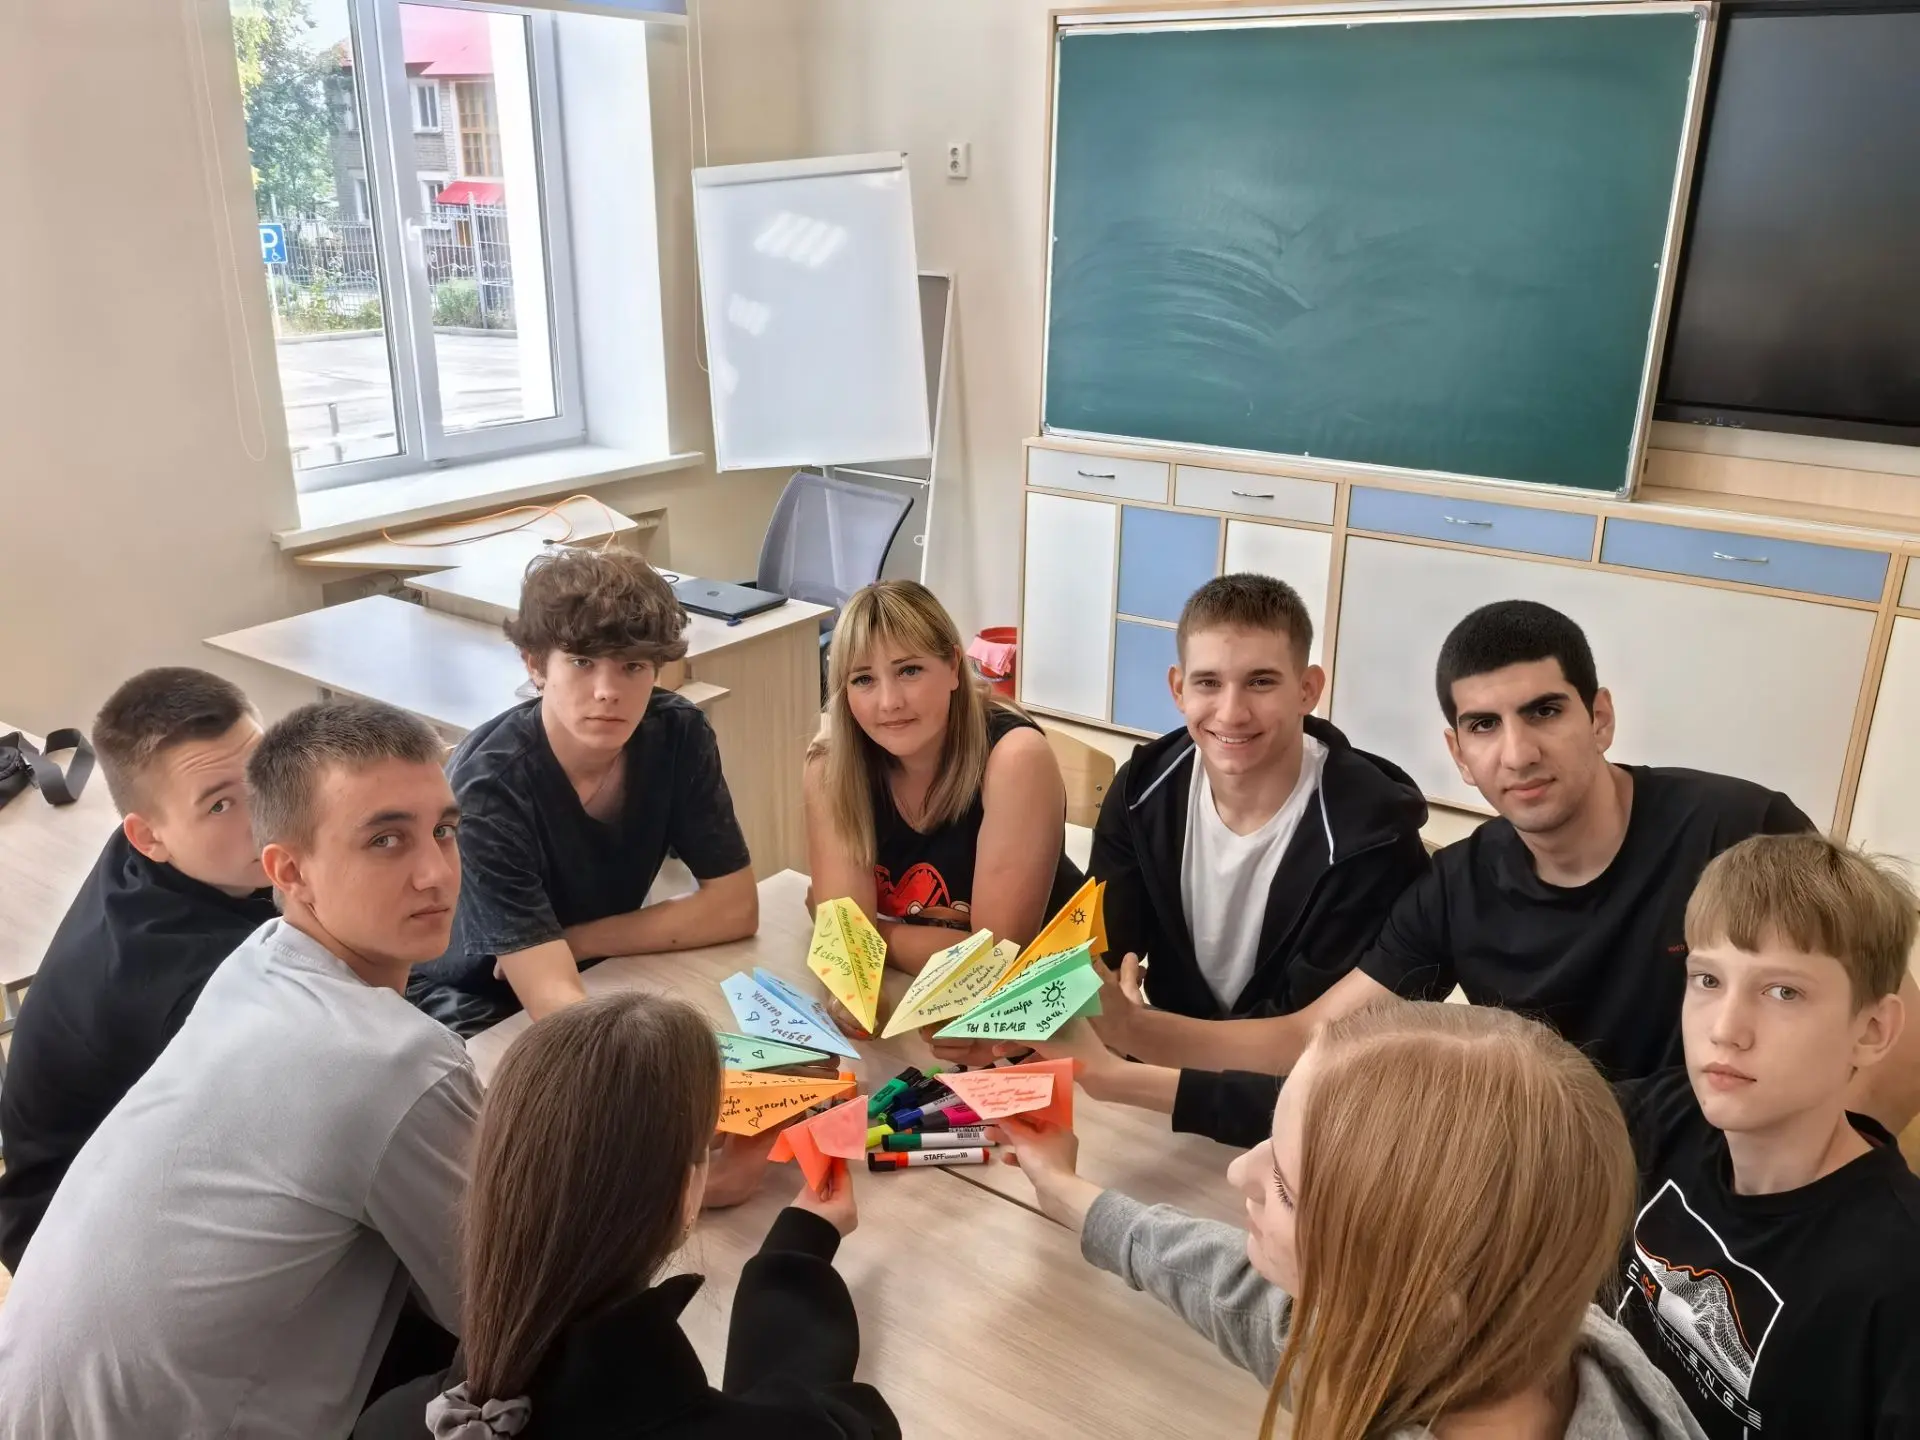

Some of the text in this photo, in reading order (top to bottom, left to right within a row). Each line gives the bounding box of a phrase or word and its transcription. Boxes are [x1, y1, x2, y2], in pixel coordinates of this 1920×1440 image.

[260, 228, 278, 259] P
[966, 1023, 979, 1033] ТЫ
[983, 1022, 990, 1032] В
[923, 1153, 945, 1161] STAFF
